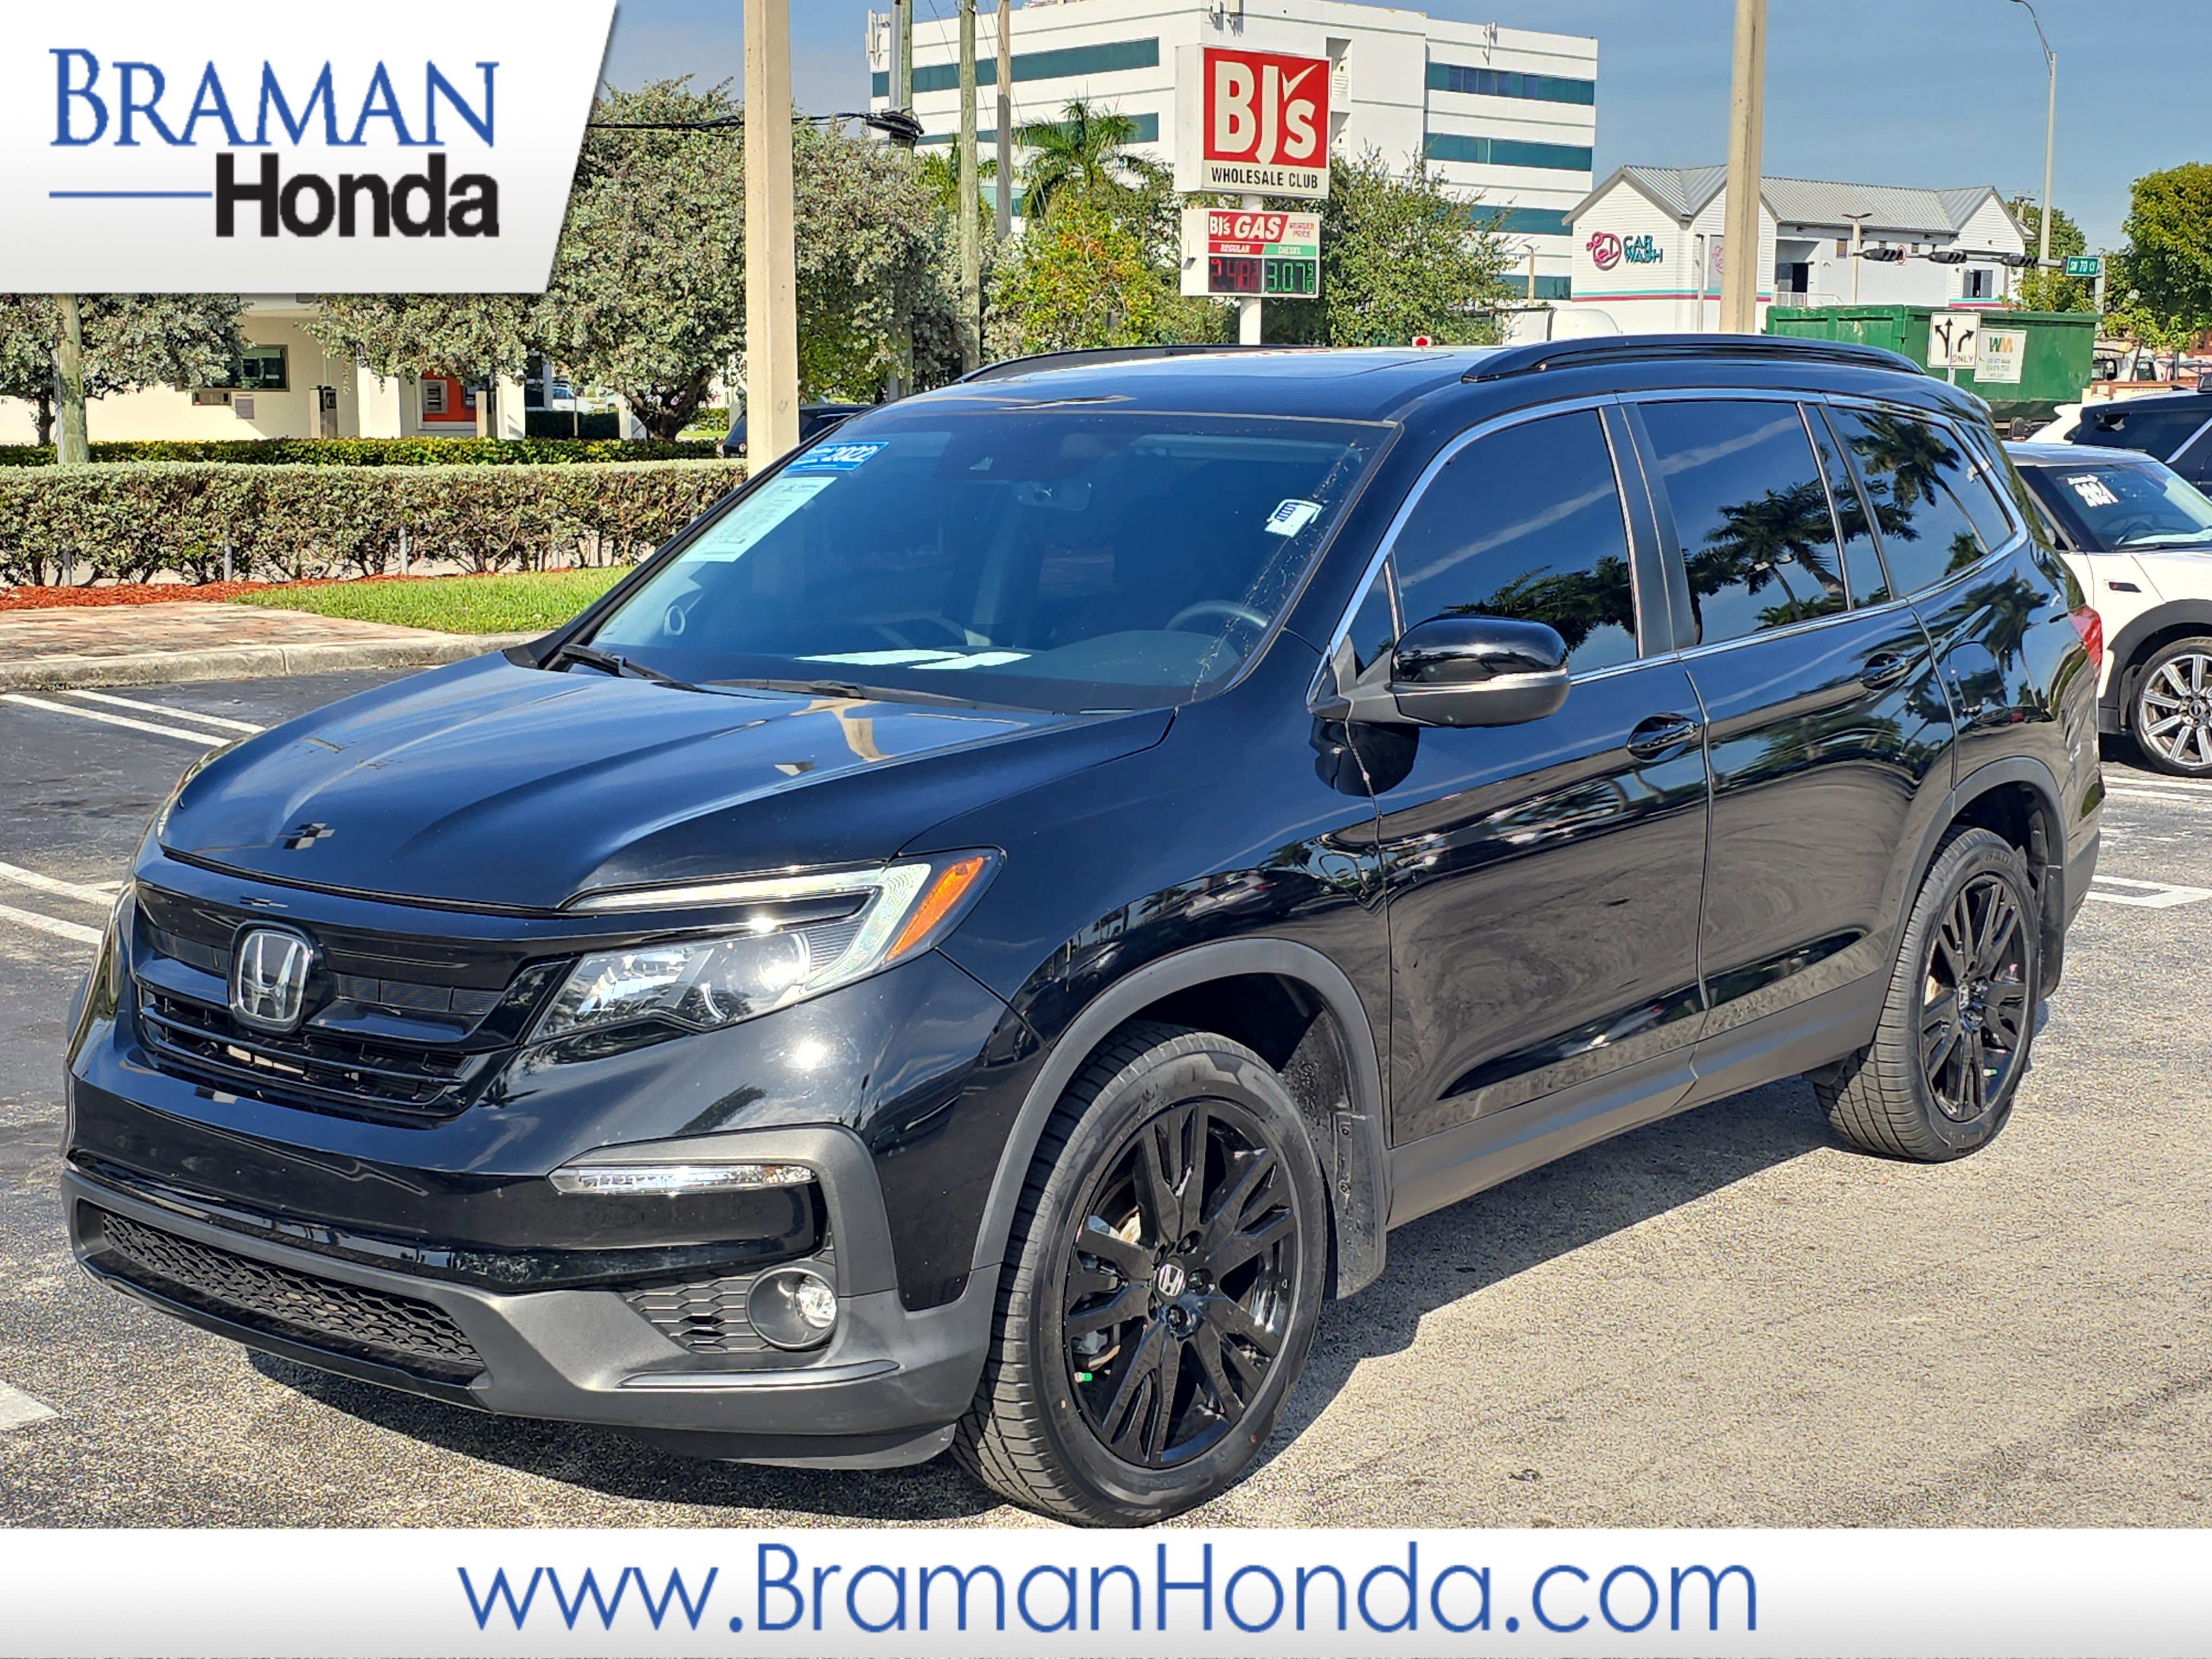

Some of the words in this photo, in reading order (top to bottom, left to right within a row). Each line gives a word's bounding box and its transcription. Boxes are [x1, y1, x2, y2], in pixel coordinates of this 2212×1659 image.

[1214, 60, 1319, 165] BJ's
[1211, 166, 1283, 186] WHOLESALE
[1289, 172, 1318, 189] CLUB
[1210, 216, 1231, 236] BJ's
[1234, 215, 1281, 240] GAS
[1220, 244, 1250, 253] REGULAR
[1278, 246, 1302, 255] DIESEL
[1623, 235, 1653, 252] CAR
[1624, 248, 1663, 264] WASH
[1989, 337, 2013, 353] WM
[1952, 355, 1973, 363] ONLY
[821, 445, 879, 462] 2022
